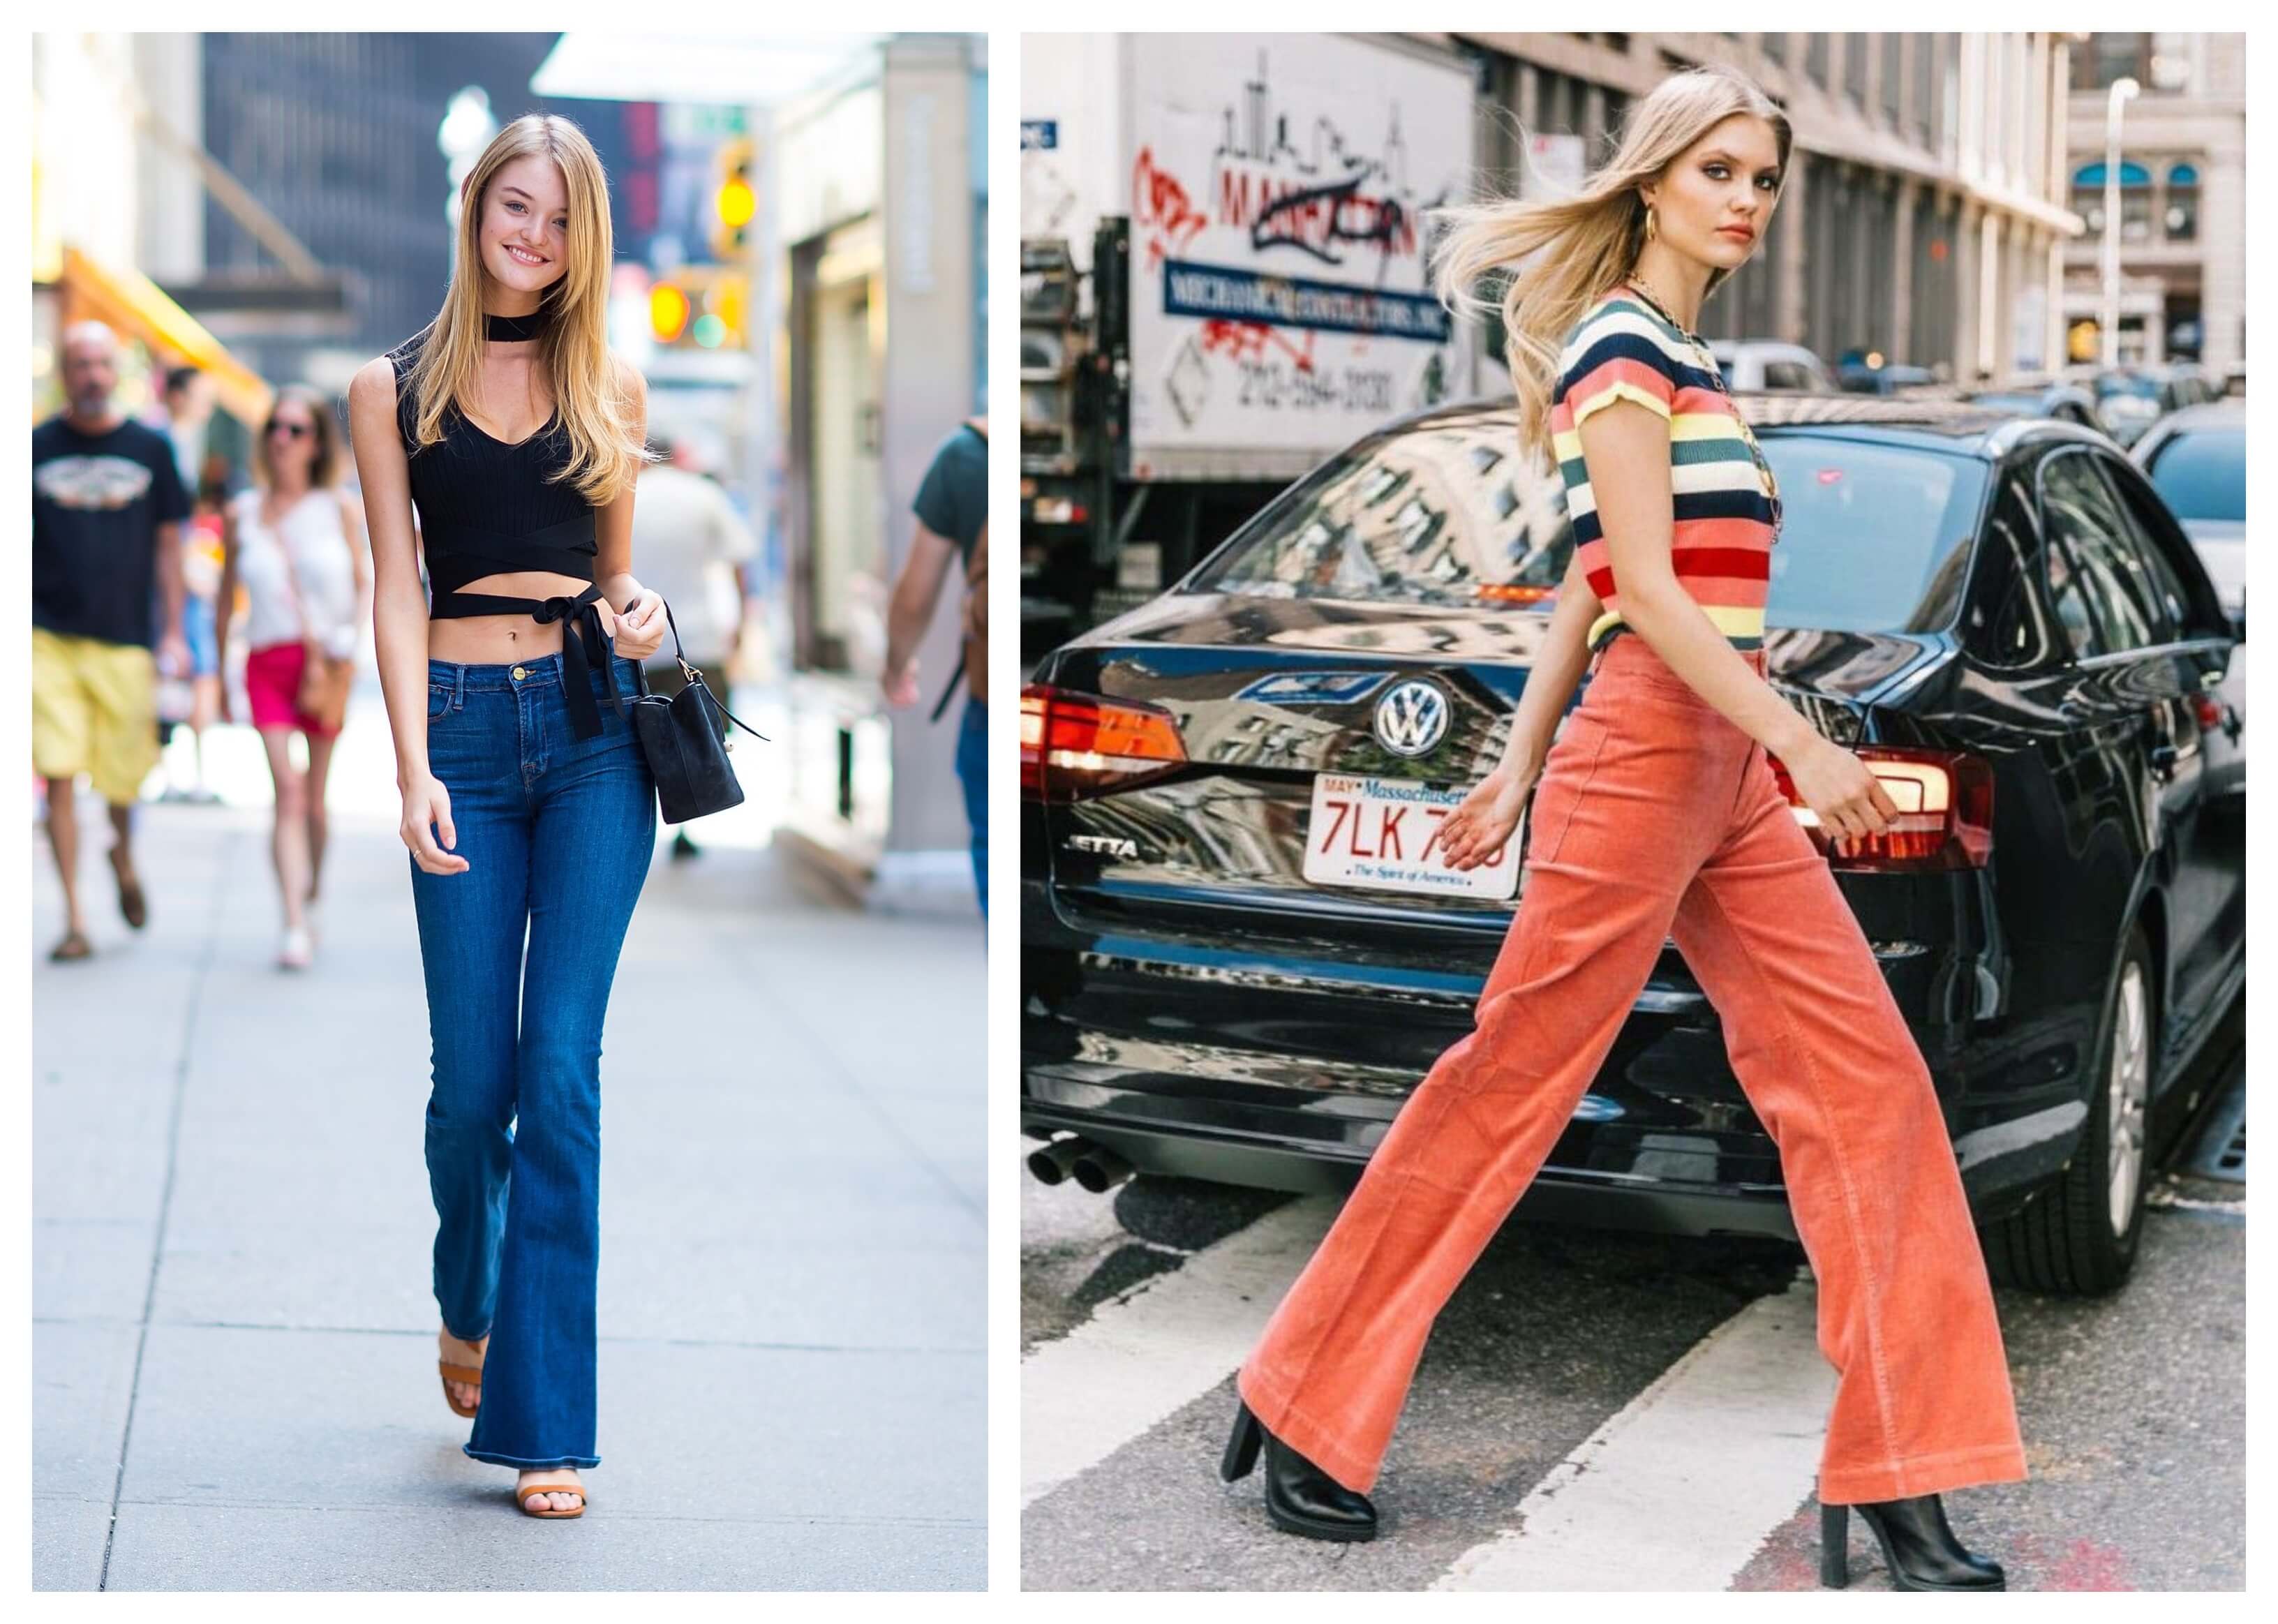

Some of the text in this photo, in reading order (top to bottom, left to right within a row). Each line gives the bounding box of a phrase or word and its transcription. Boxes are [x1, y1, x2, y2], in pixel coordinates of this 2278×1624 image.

[1325, 778, 1467, 804] MAY Massachuset
[1321, 802, 1407, 860] 7LK
[1355, 864, 1373, 875] The
[1377, 866, 1404, 879] Spirit
[1420, 872, 1464, 885] America
